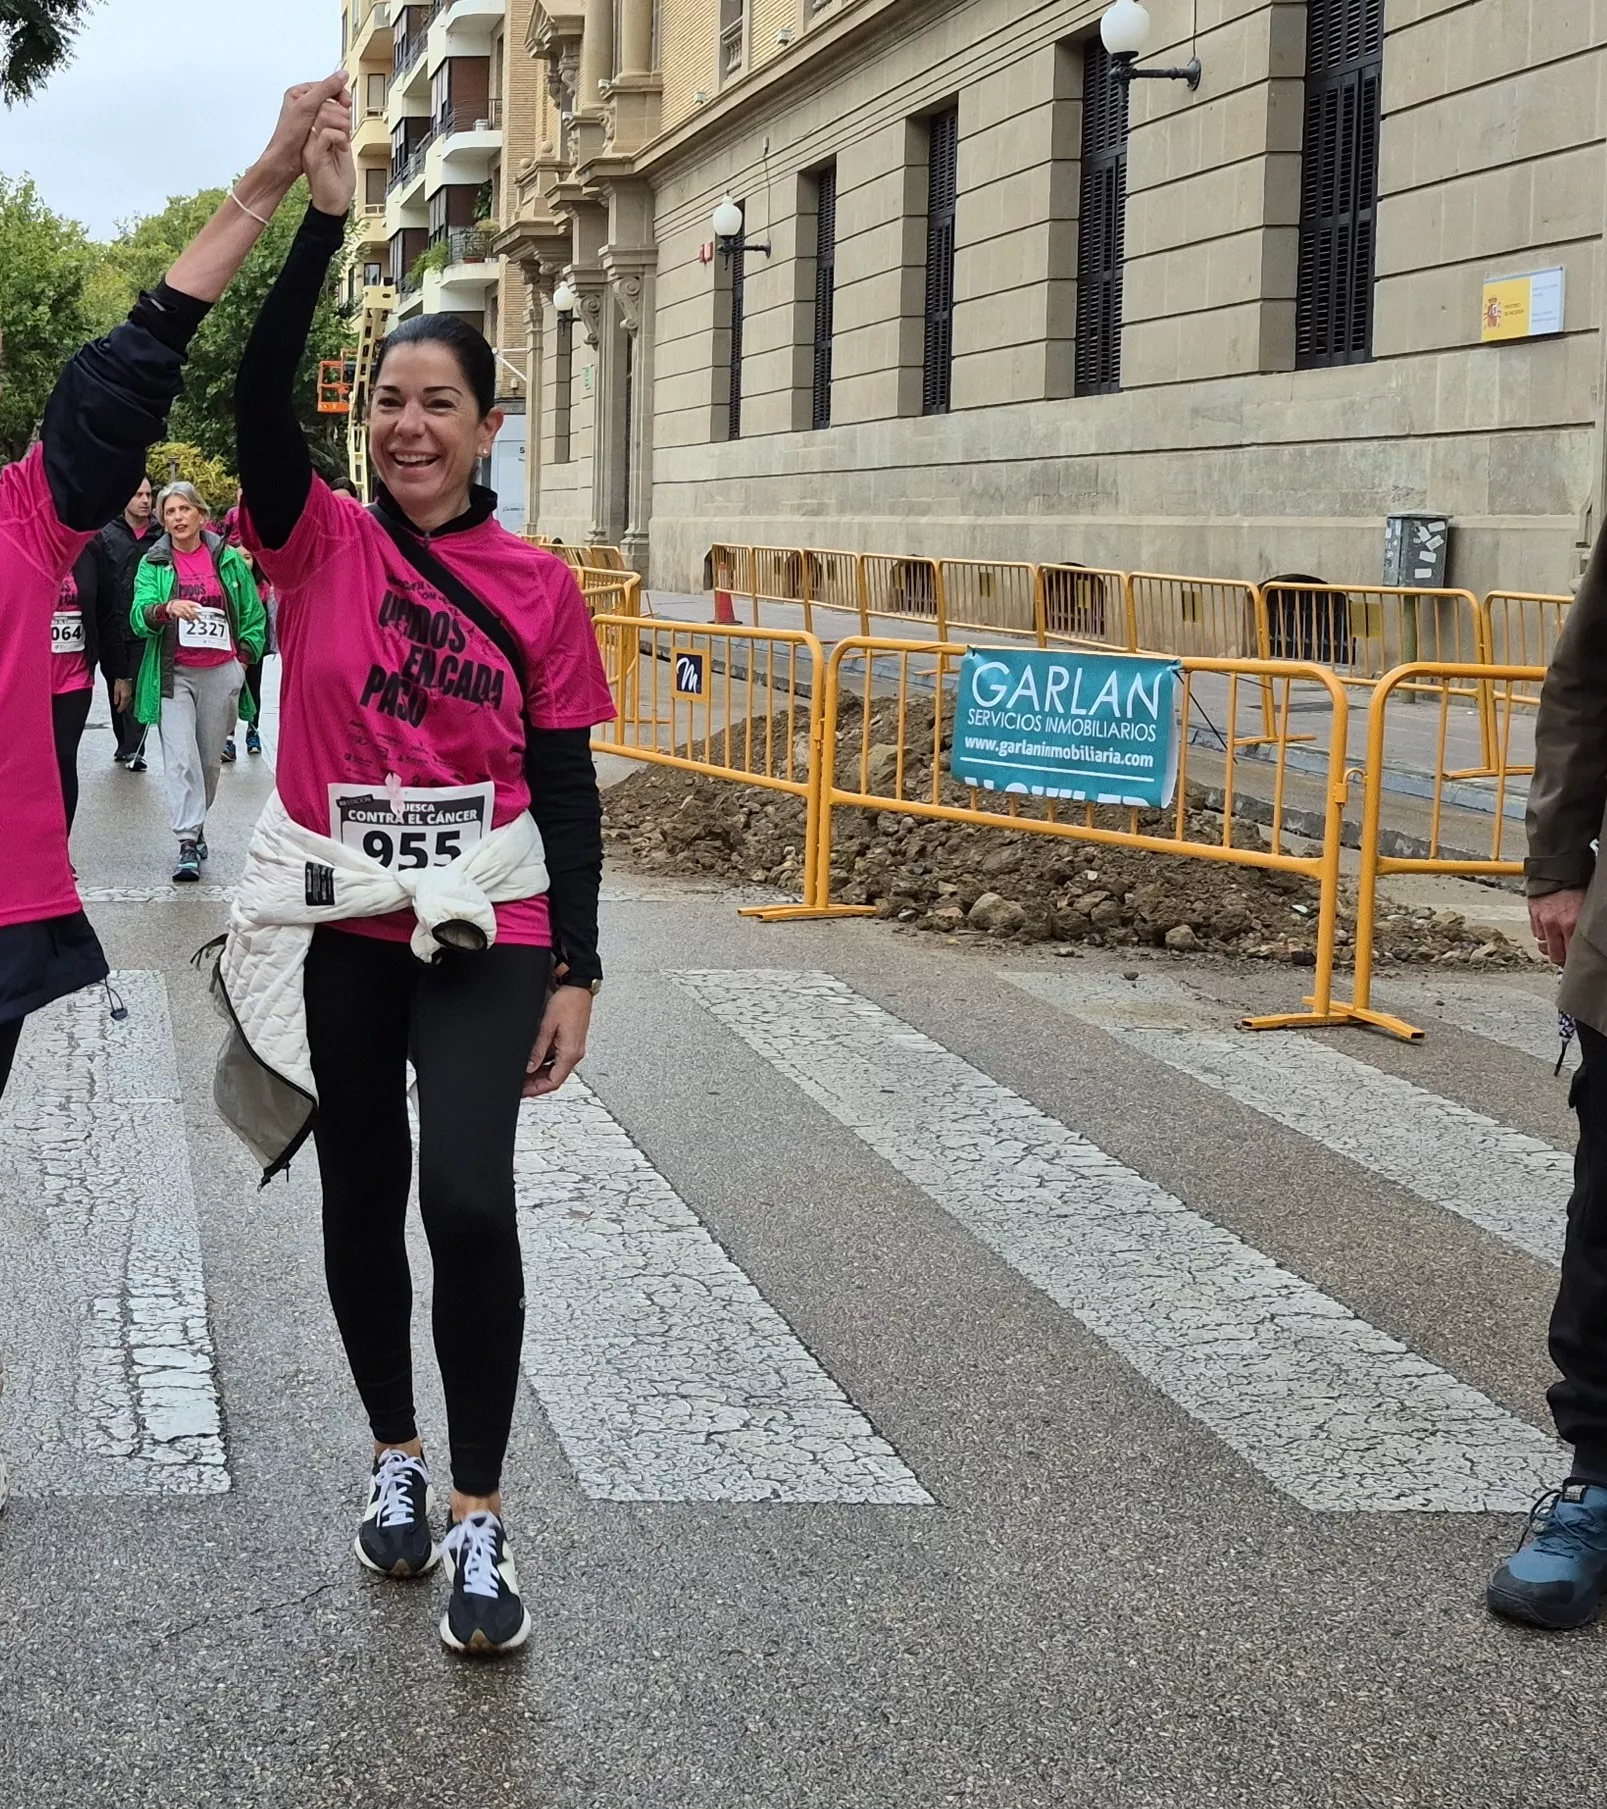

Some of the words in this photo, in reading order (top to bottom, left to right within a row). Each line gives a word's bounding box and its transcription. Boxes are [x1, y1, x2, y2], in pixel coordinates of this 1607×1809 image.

[186, 621, 225, 638] 2327
[439, 655, 505, 710] CADA
[972, 661, 1163, 721] GARLAN
[968, 708, 1042, 732] SERVICIOS
[1045, 716, 1157, 742] INMOBILIARIOS
[965, 736, 1154, 768] www.garlaninmobiliaria.com
[348, 810, 404, 824] CONTRA
[408, 814, 423, 824] EL
[427, 810, 477, 824] CÁNCER
[404, 803, 435, 813] UESCA
[363, 830, 462, 871] 955
